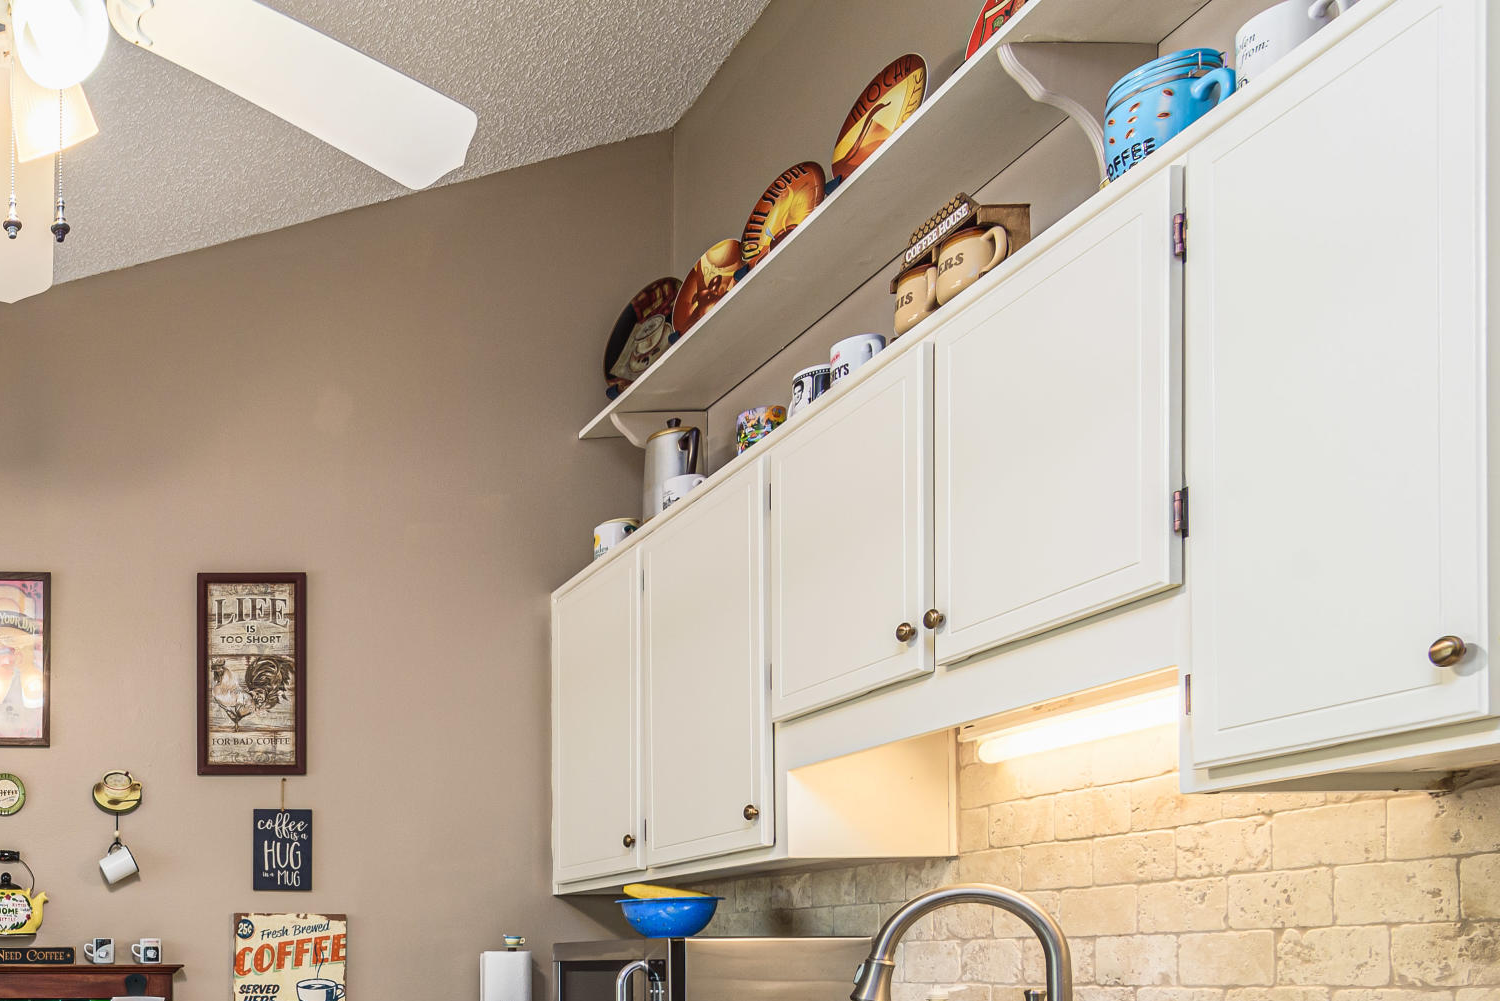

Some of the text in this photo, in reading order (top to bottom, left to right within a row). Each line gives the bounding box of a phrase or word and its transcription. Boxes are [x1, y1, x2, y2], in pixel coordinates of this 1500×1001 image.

[1107, 138, 1156, 177] OFFEE
[762, 164, 809, 206] SHOPPE
[905, 203, 969, 262] COFFEE HOUSE
[939, 253, 964, 274] ERS
[214, 597, 289, 630] LIFE
[20, 617, 38, 636] DAY
[246, 625, 256, 633] IS
[220, 635, 282, 644] TOO SHORT
[212, 737, 291, 746] FOR BAD COFFEE
[257, 812, 309, 839] coffee
[290, 832, 299, 841] is
[263, 840, 301, 871] HUG
[277, 869, 300, 887] MUG
[238, 920, 331, 940] 25¢ Fresh Brewed
[26, 949, 65, 961] COFFEE
[235, 934, 346, 976] COFFEE
[238, 984, 280, 995] SERVED
